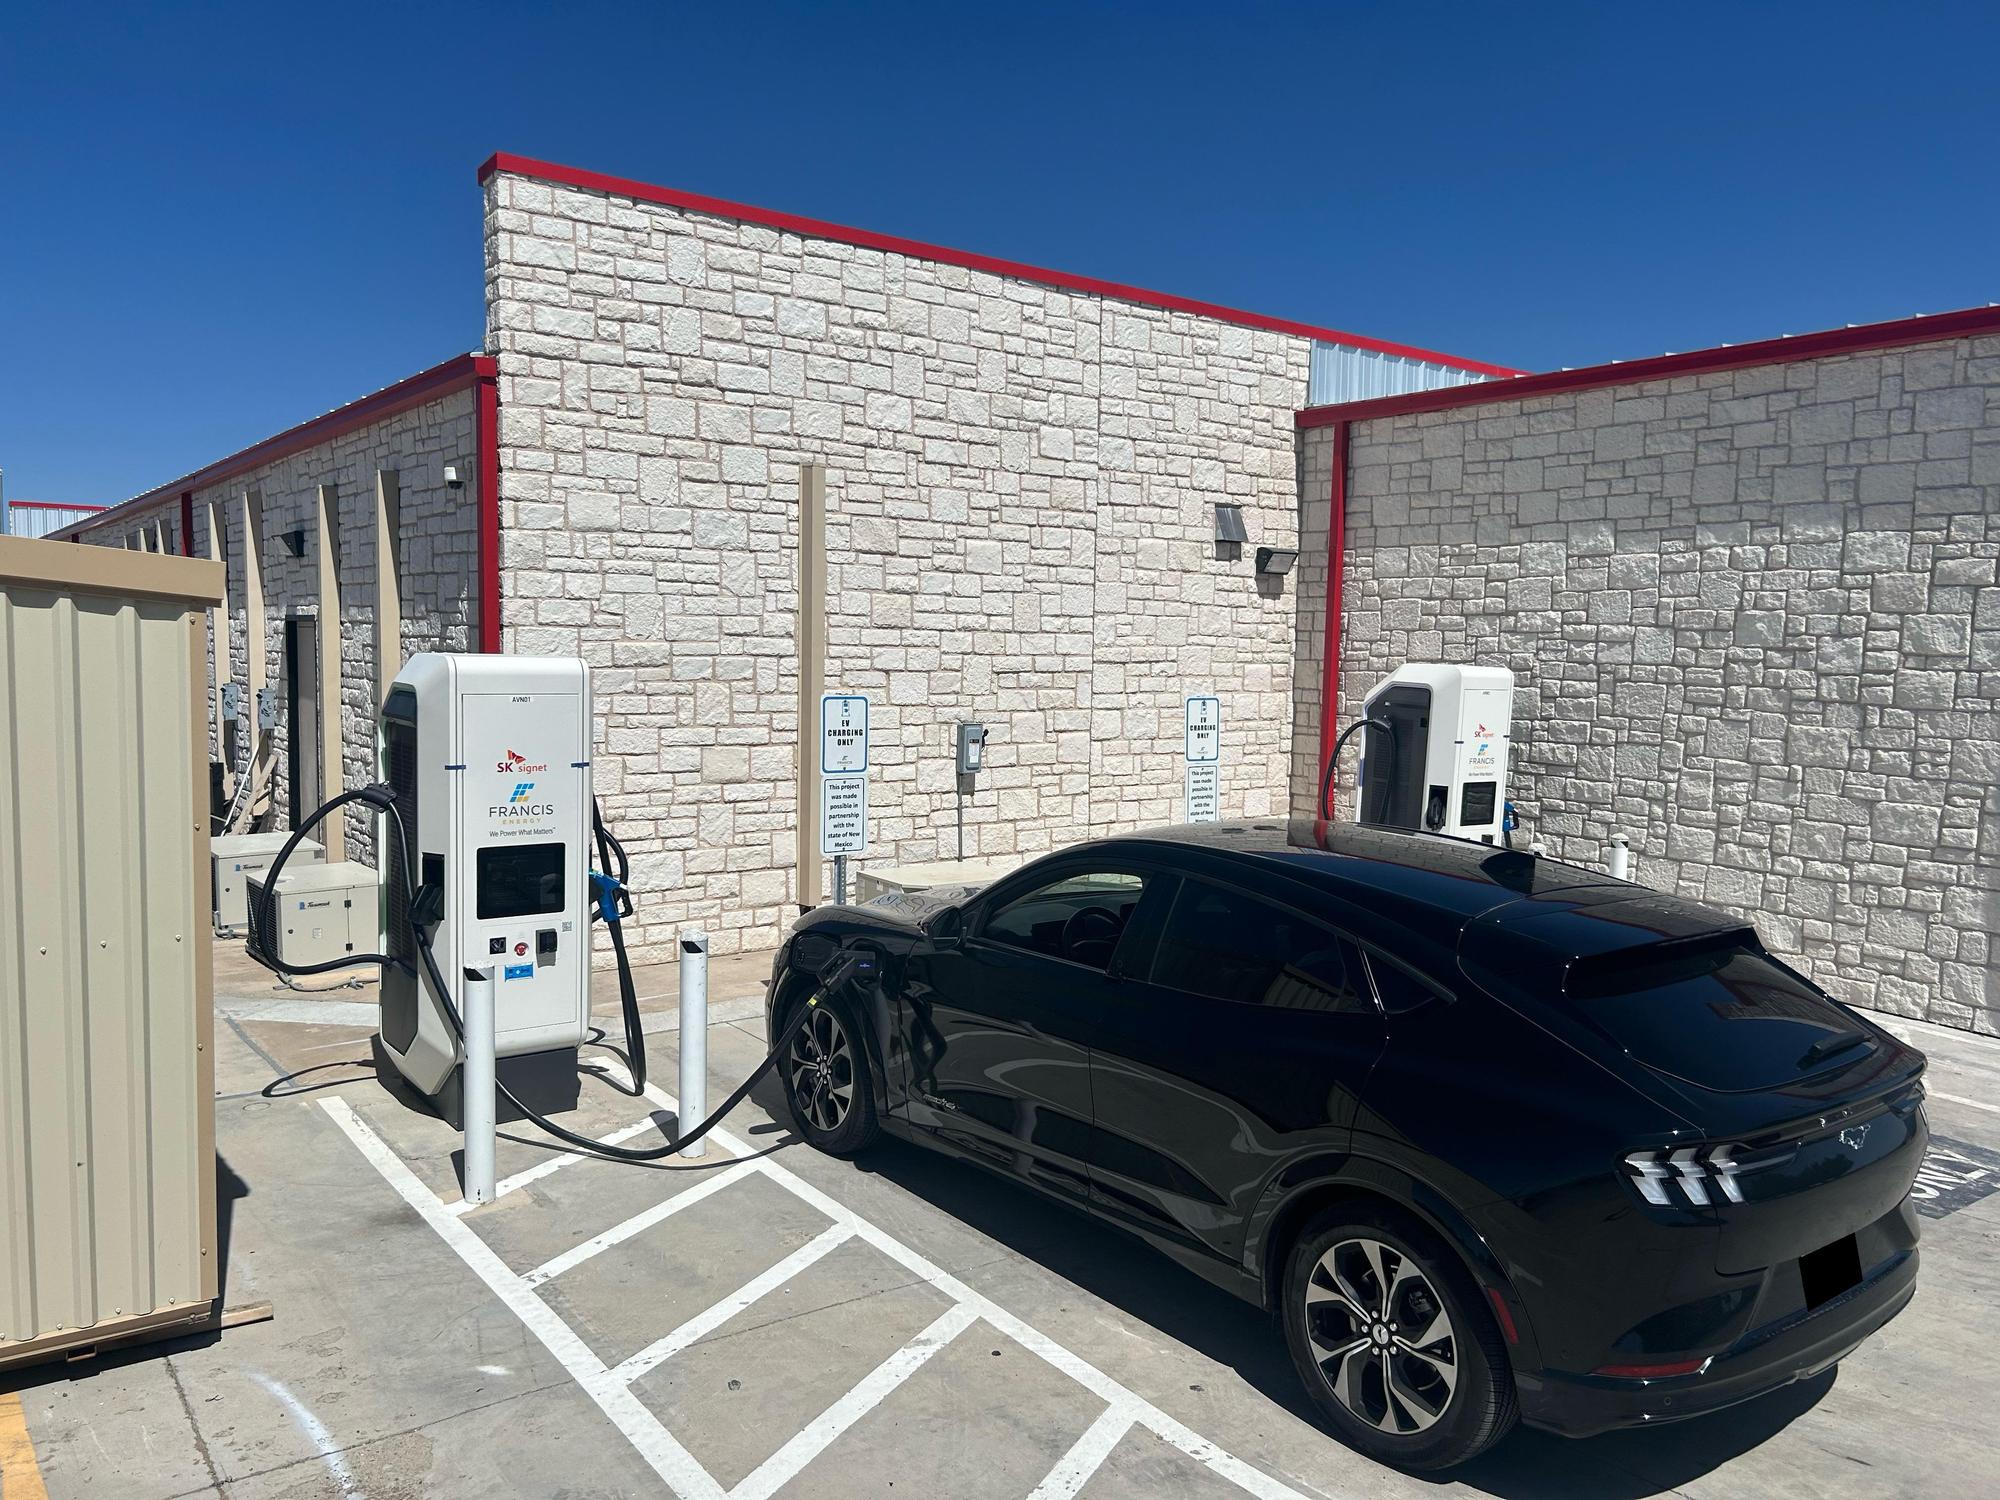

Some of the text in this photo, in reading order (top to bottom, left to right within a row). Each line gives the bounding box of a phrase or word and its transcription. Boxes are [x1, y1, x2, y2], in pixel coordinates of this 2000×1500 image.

[841, 719, 850, 727] EV
[827, 729, 864, 737] CHARGING
[1469, 757, 1495, 765] FRANCIS
[497, 762, 547, 775] SK signet
[840, 783, 860, 791] project
[489, 804, 554, 818] FRANCIS
[830, 803, 852, 811] possible
[828, 812, 860, 820] partnership
